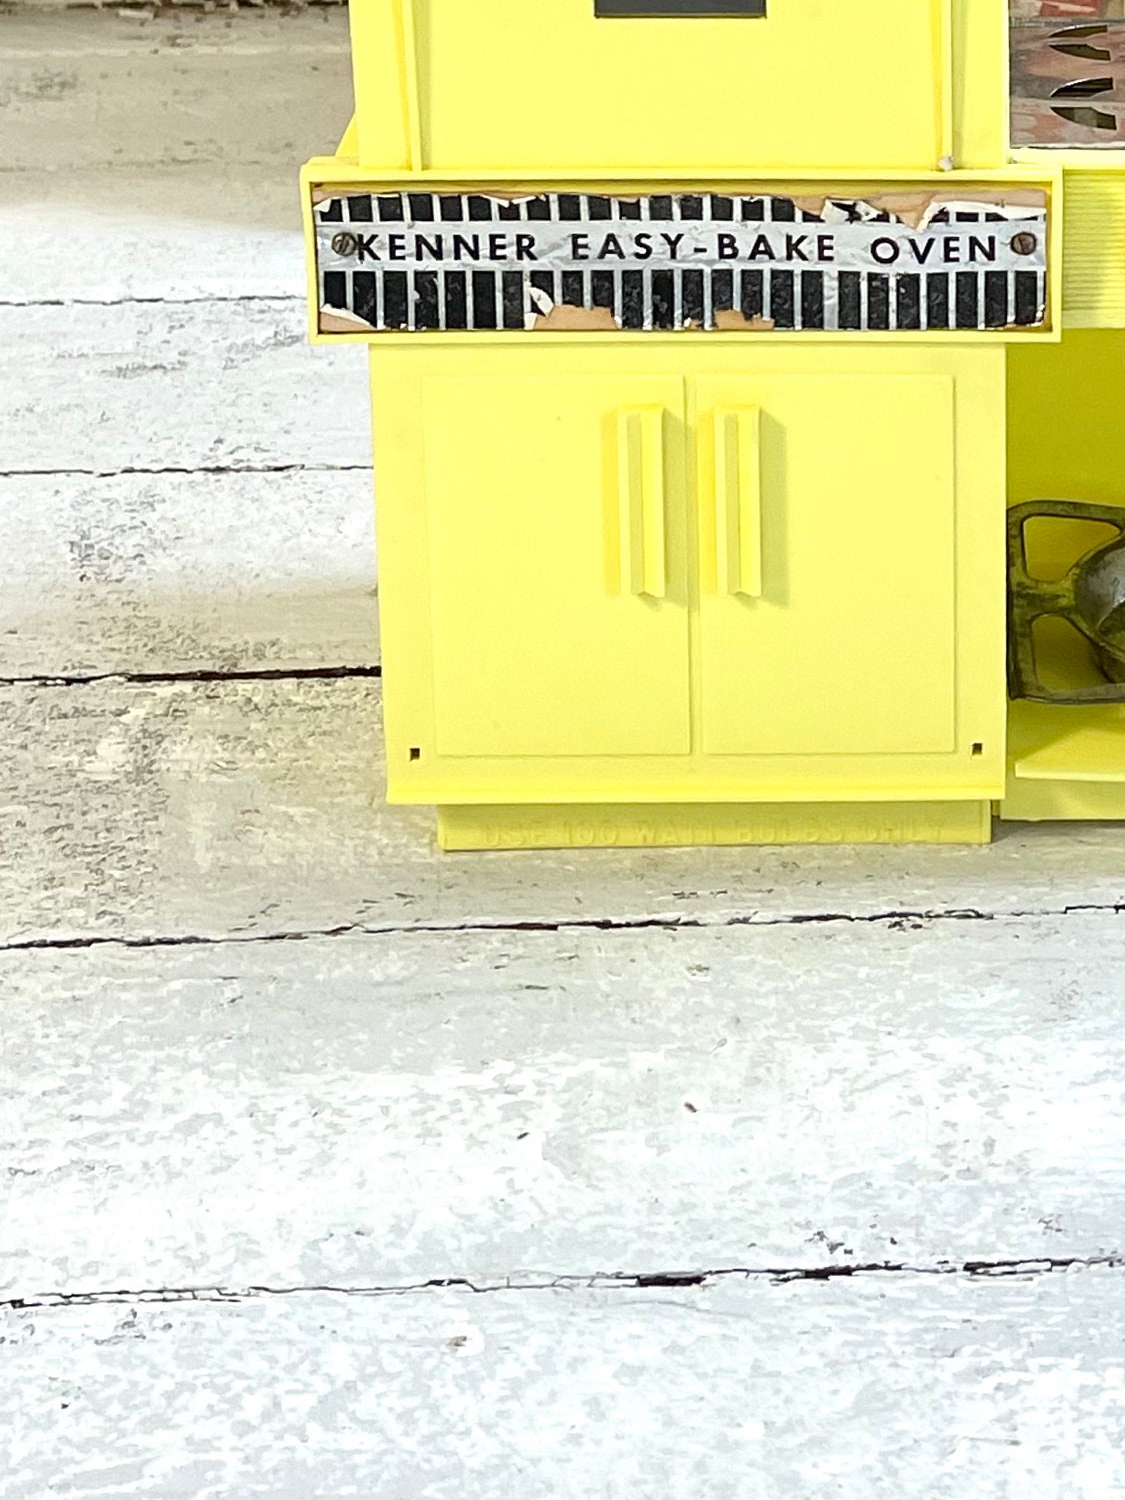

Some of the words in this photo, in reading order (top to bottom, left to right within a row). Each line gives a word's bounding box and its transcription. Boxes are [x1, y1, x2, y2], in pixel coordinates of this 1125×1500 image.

[356, 232, 538, 263] KENNER
[570, 232, 835, 262] EASY-BAKE
[869, 235, 997, 266] OVEN
